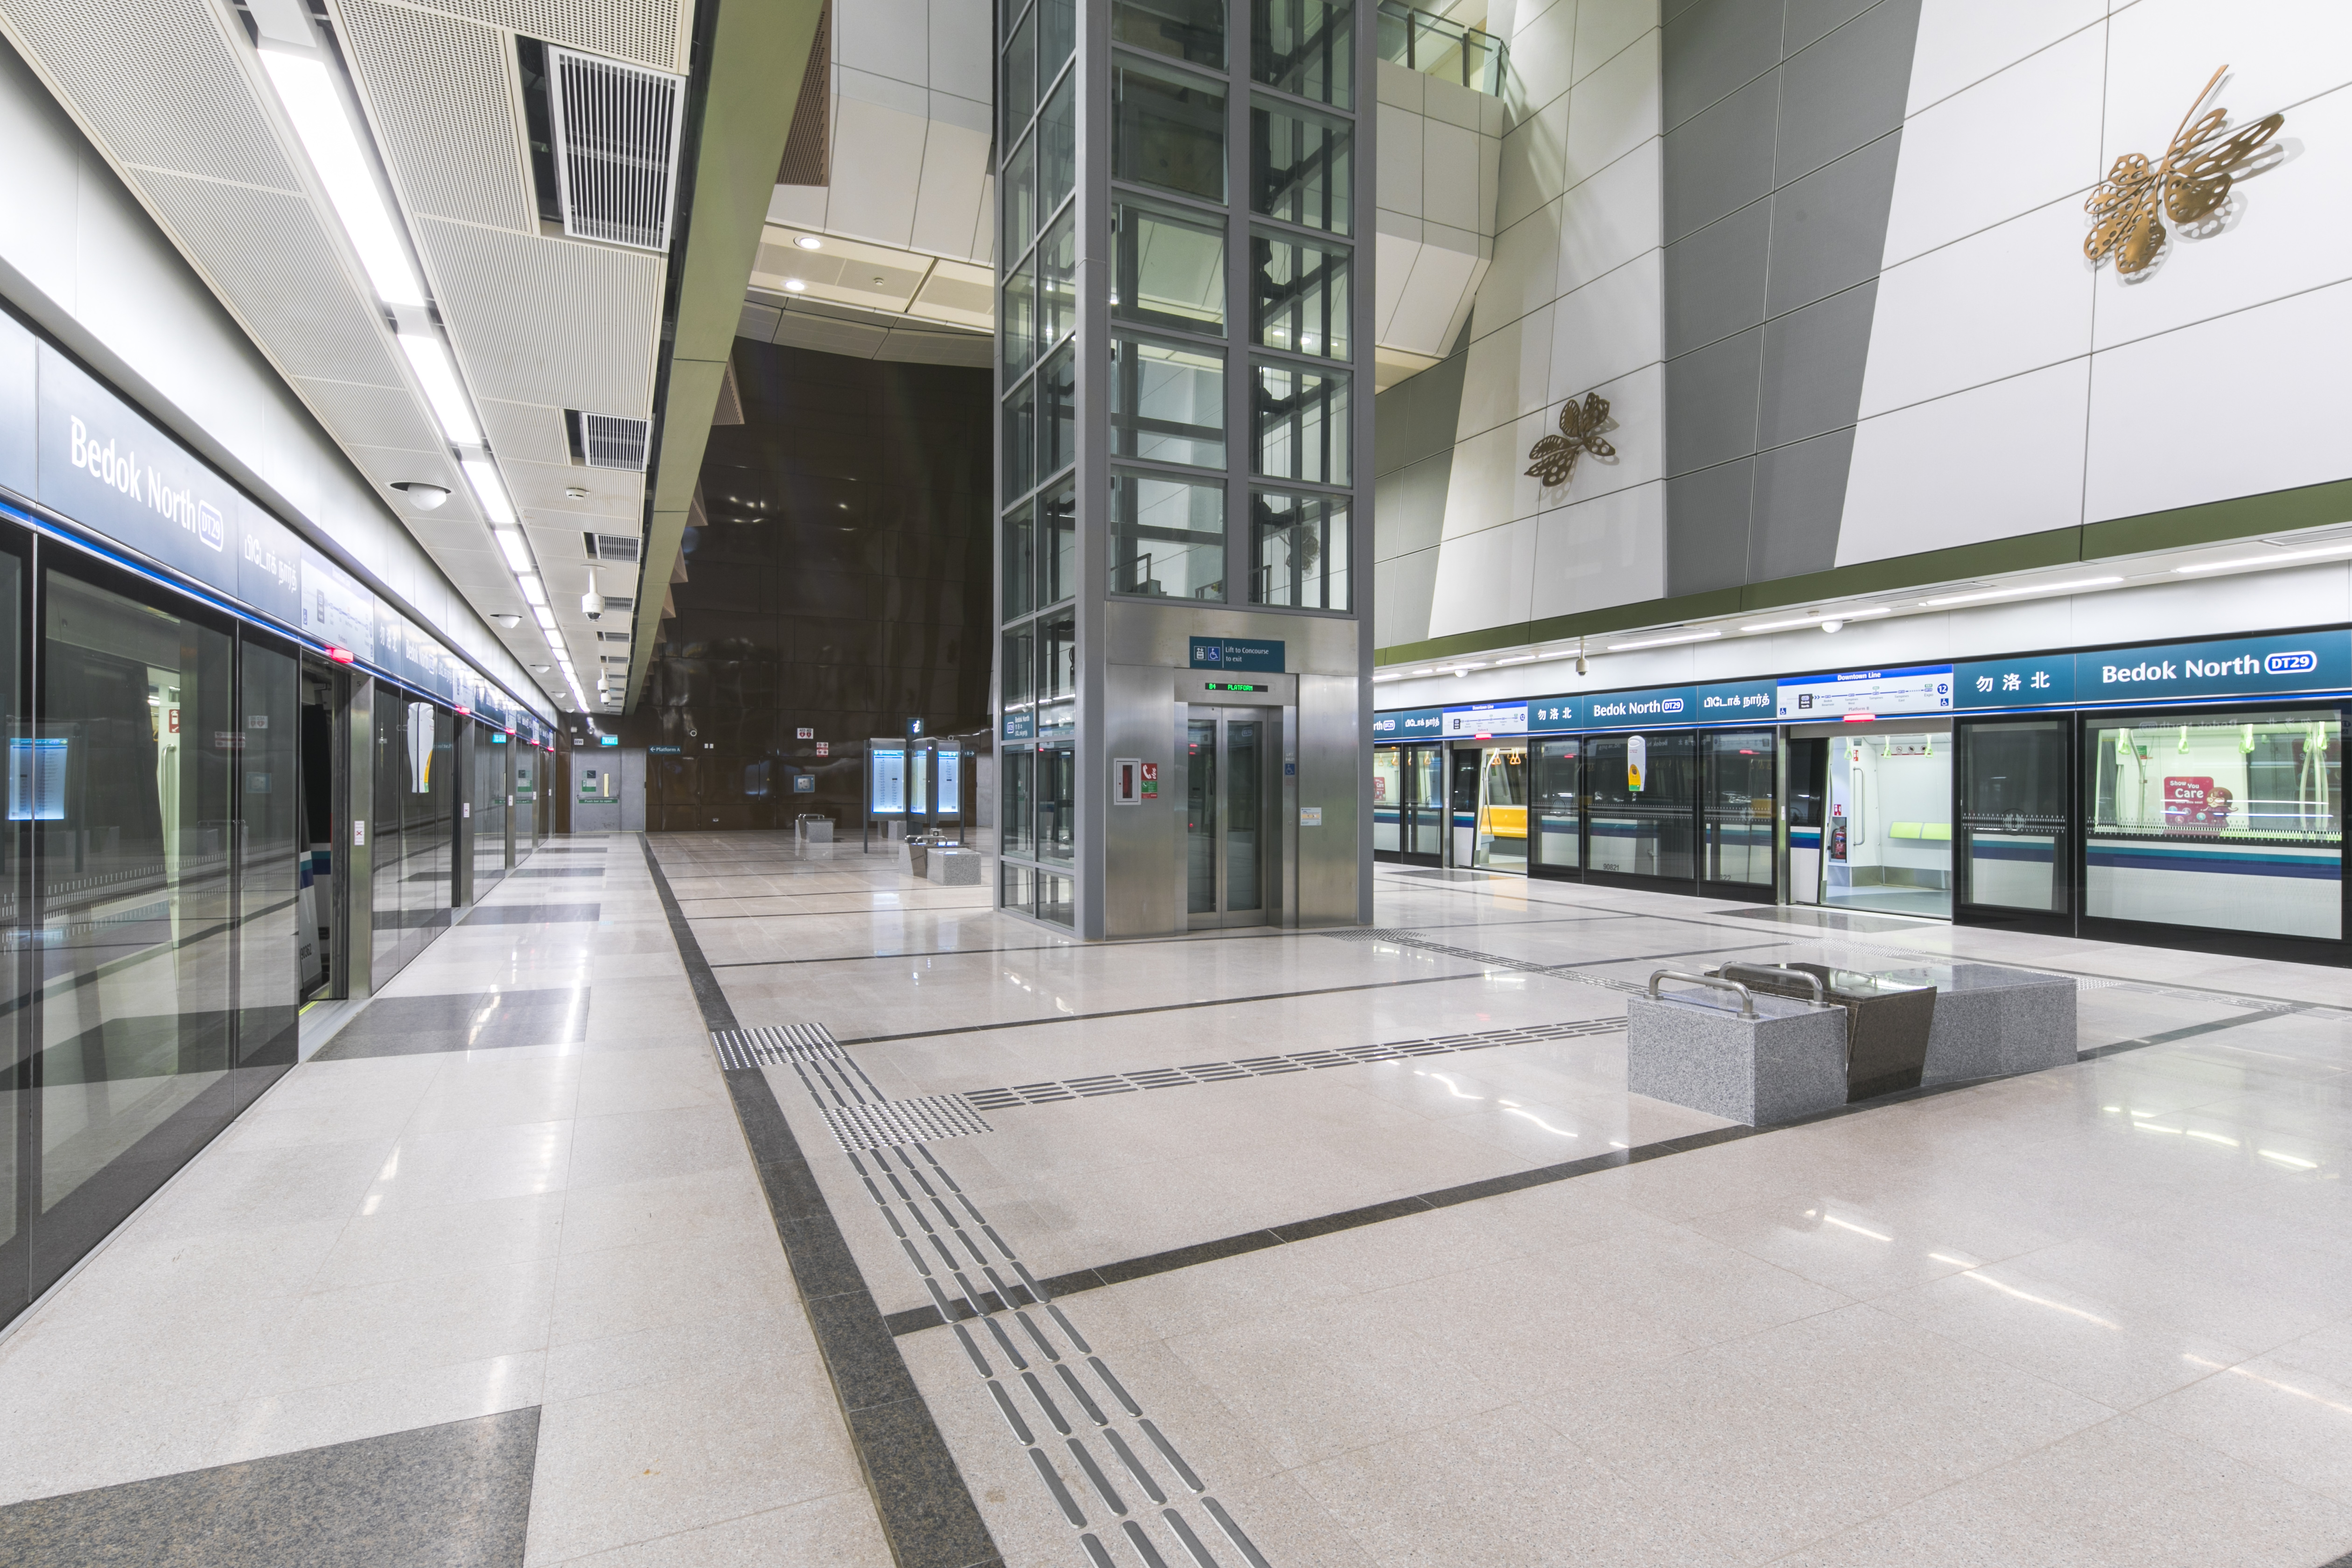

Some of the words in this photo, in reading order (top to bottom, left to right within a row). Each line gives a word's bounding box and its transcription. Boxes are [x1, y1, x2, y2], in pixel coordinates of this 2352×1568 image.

[71, 415, 141, 502] Bedok
[148, 465, 196, 533] North
[202, 511, 220, 540] DT29
[2102, 660, 2177, 683] Bedok
[2185, 654, 2260, 678] North
[2271, 656, 2310, 669] DT29
[1976, 671, 2050, 692] 勿洛北
[1594, 703, 1626, 717] Bedok
[1629, 700, 1660, 714] North
[1704, 695, 1741, 707] பிடோக்
[1743, 693, 1770, 708] நார்த்
[1538, 707, 1572, 721] 勿洛北
[1373, 721, 1383, 730] rth
[2175, 788, 2204, 798] Care
